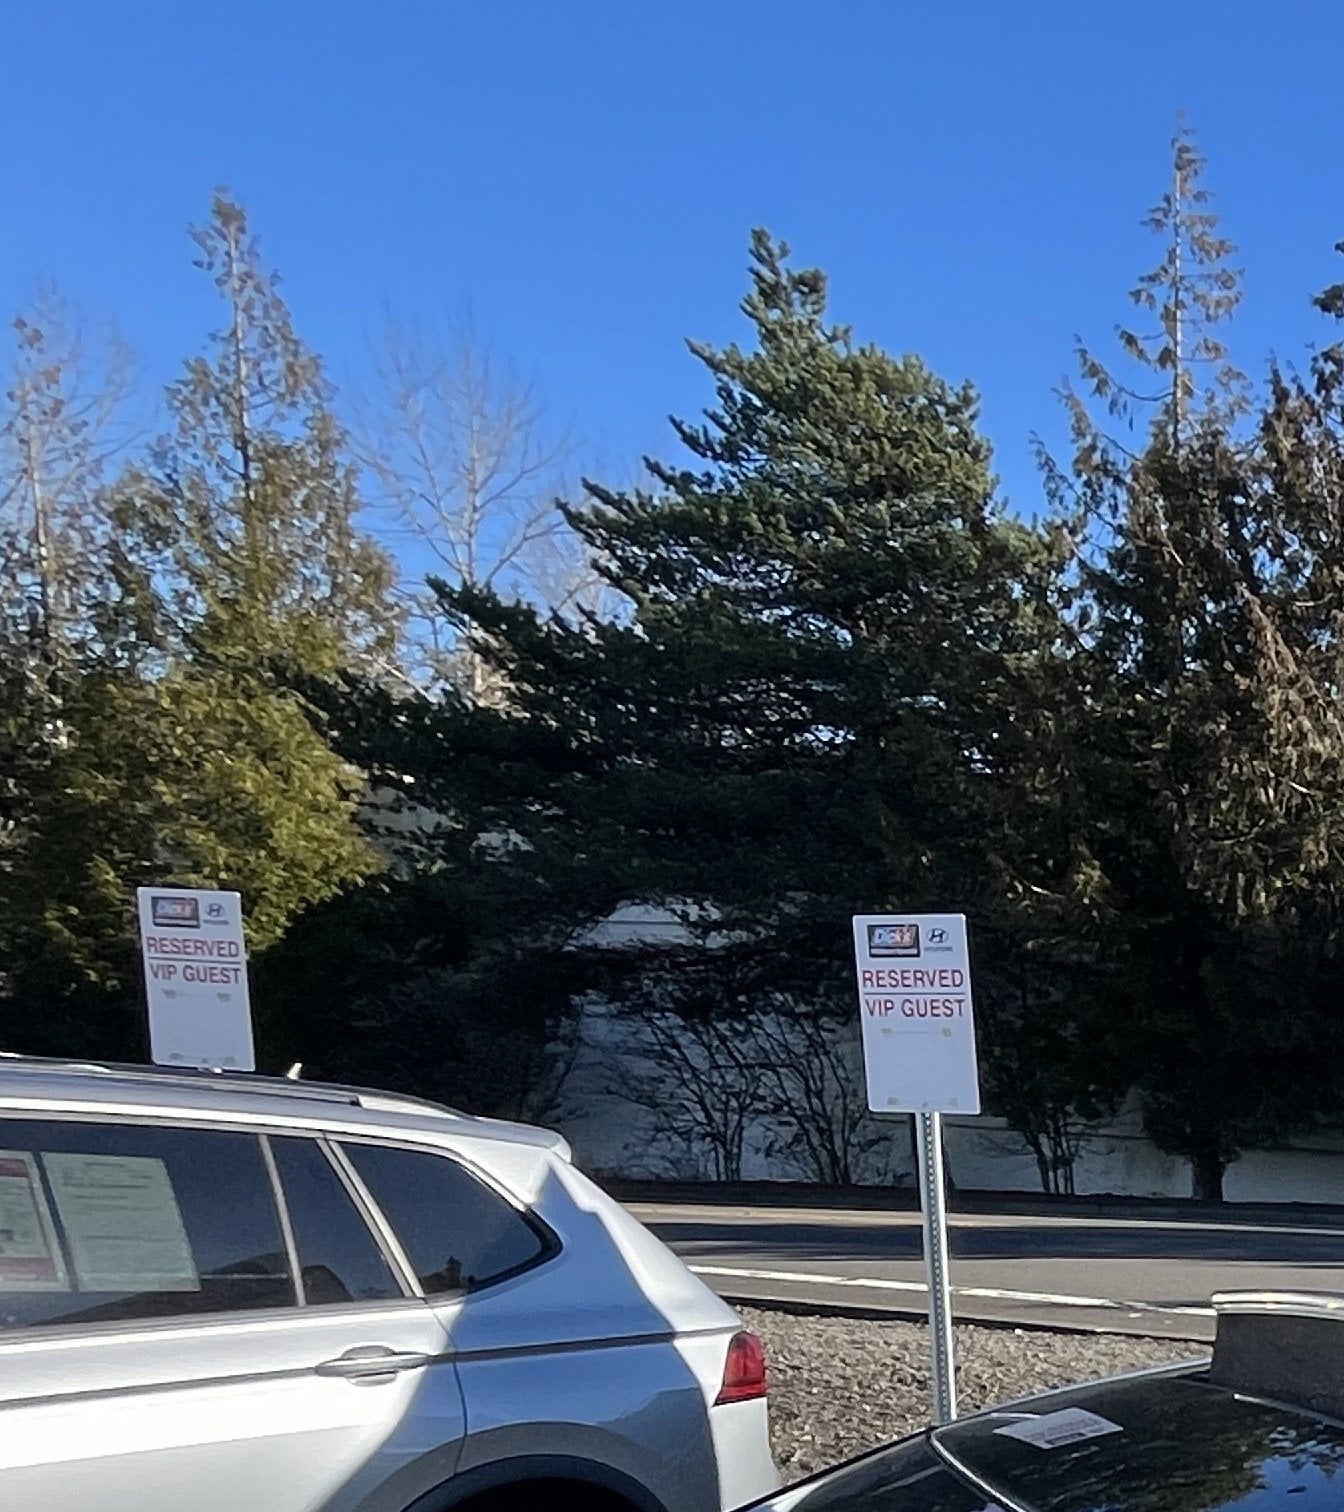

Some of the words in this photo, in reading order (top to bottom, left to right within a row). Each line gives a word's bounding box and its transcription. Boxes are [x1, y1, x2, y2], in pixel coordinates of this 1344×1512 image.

[146, 936, 240, 958] RESERVED
[149, 963, 177, 981] VIP
[182, 964, 242, 985] GUEST
[862, 969, 964, 988] RESERVED
[865, 998, 894, 1018] VIP
[901, 998, 965, 1018] GUEST
